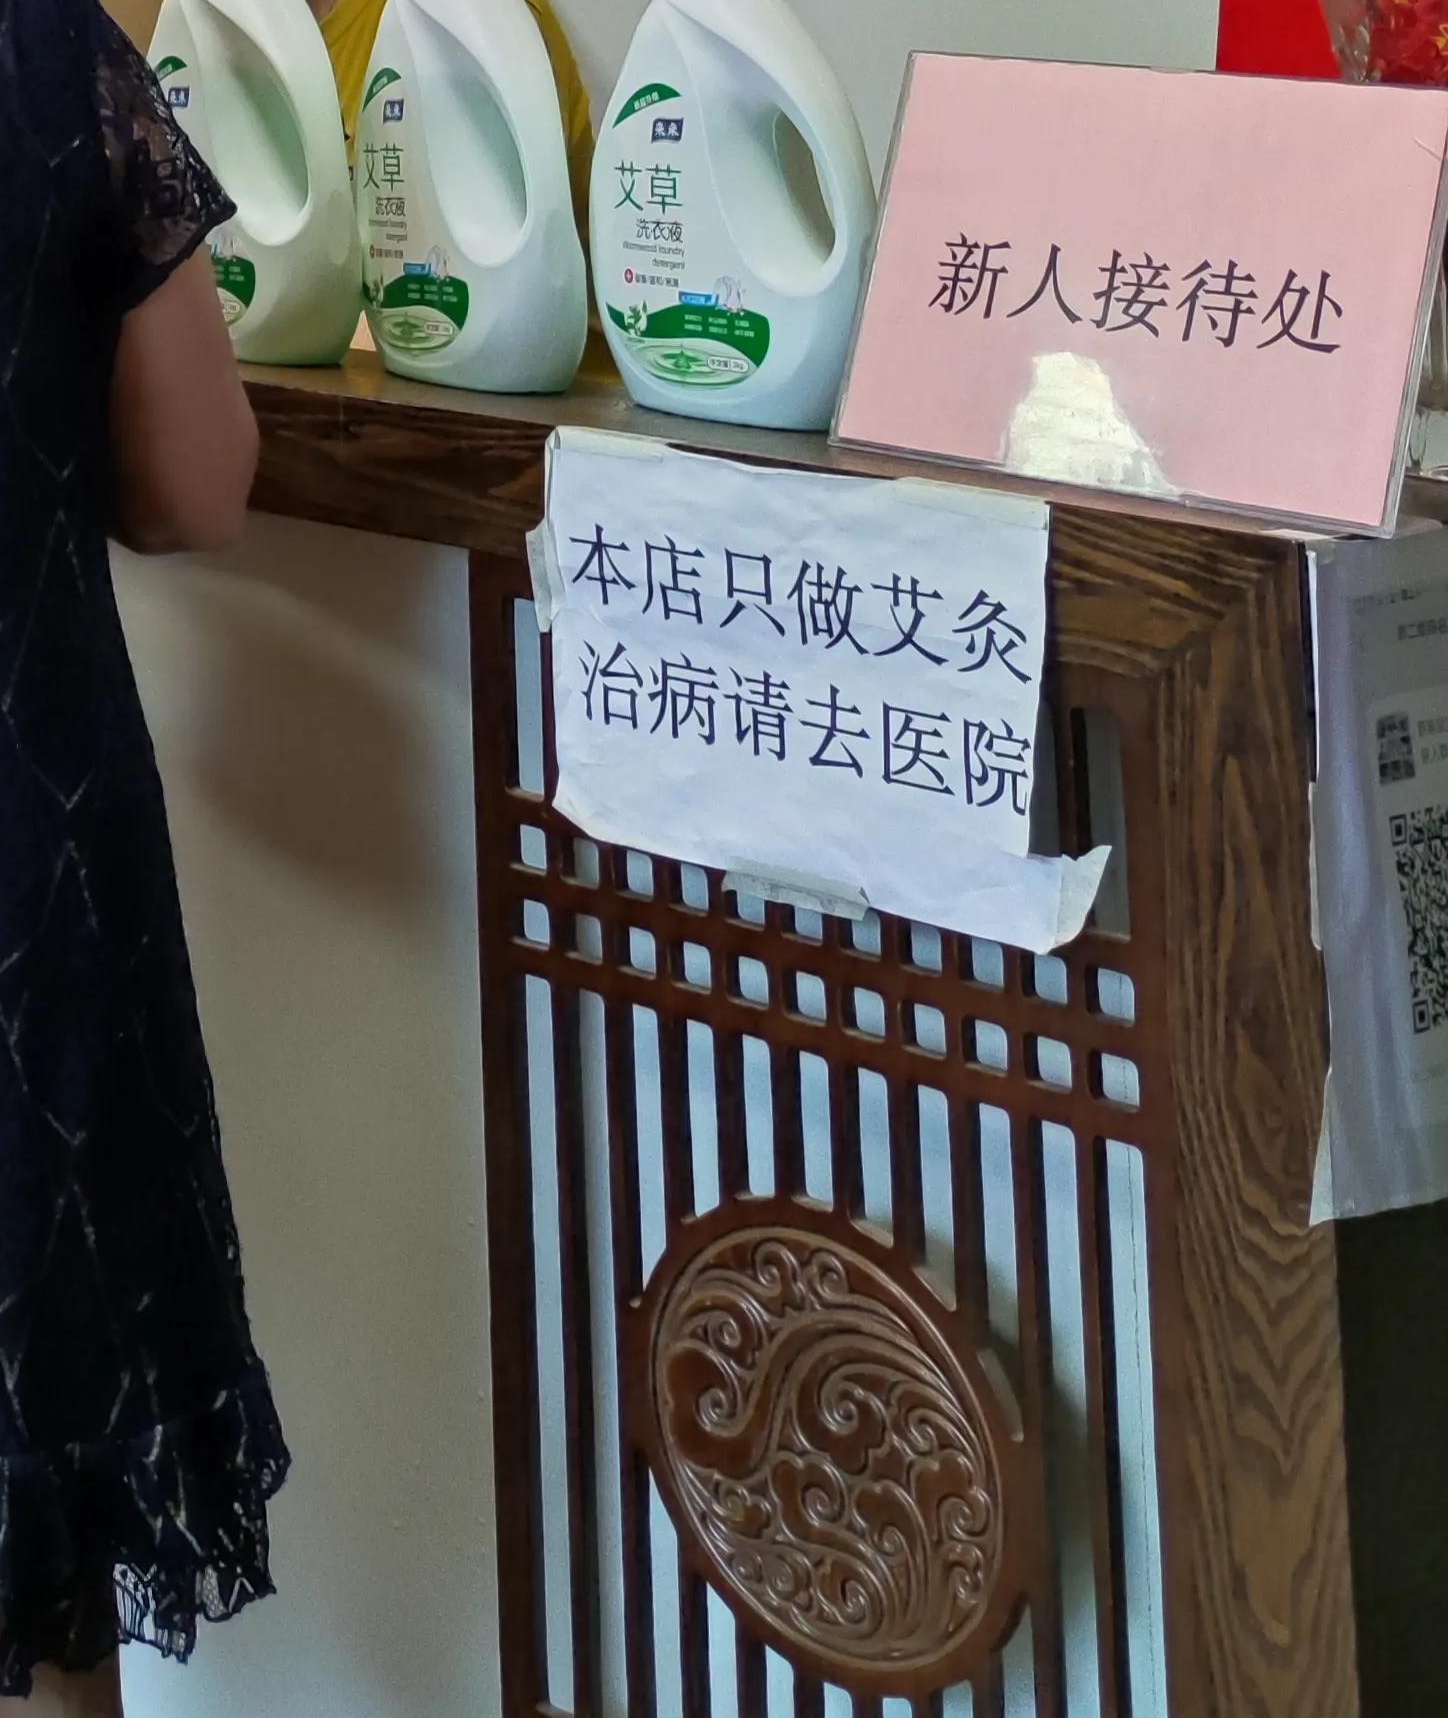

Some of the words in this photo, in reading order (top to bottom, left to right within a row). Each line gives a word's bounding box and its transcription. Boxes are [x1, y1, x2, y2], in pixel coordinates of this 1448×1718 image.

[362, 142, 405, 190] 艾草
[614, 159, 683, 215] 艾草
[636, 218, 684, 243] 洗衣液
[928, 231, 1344, 355] 新人接待处
[569, 523, 1033, 685] 本店只做艾灸
[577, 638, 1032, 817] 治病请去医院
